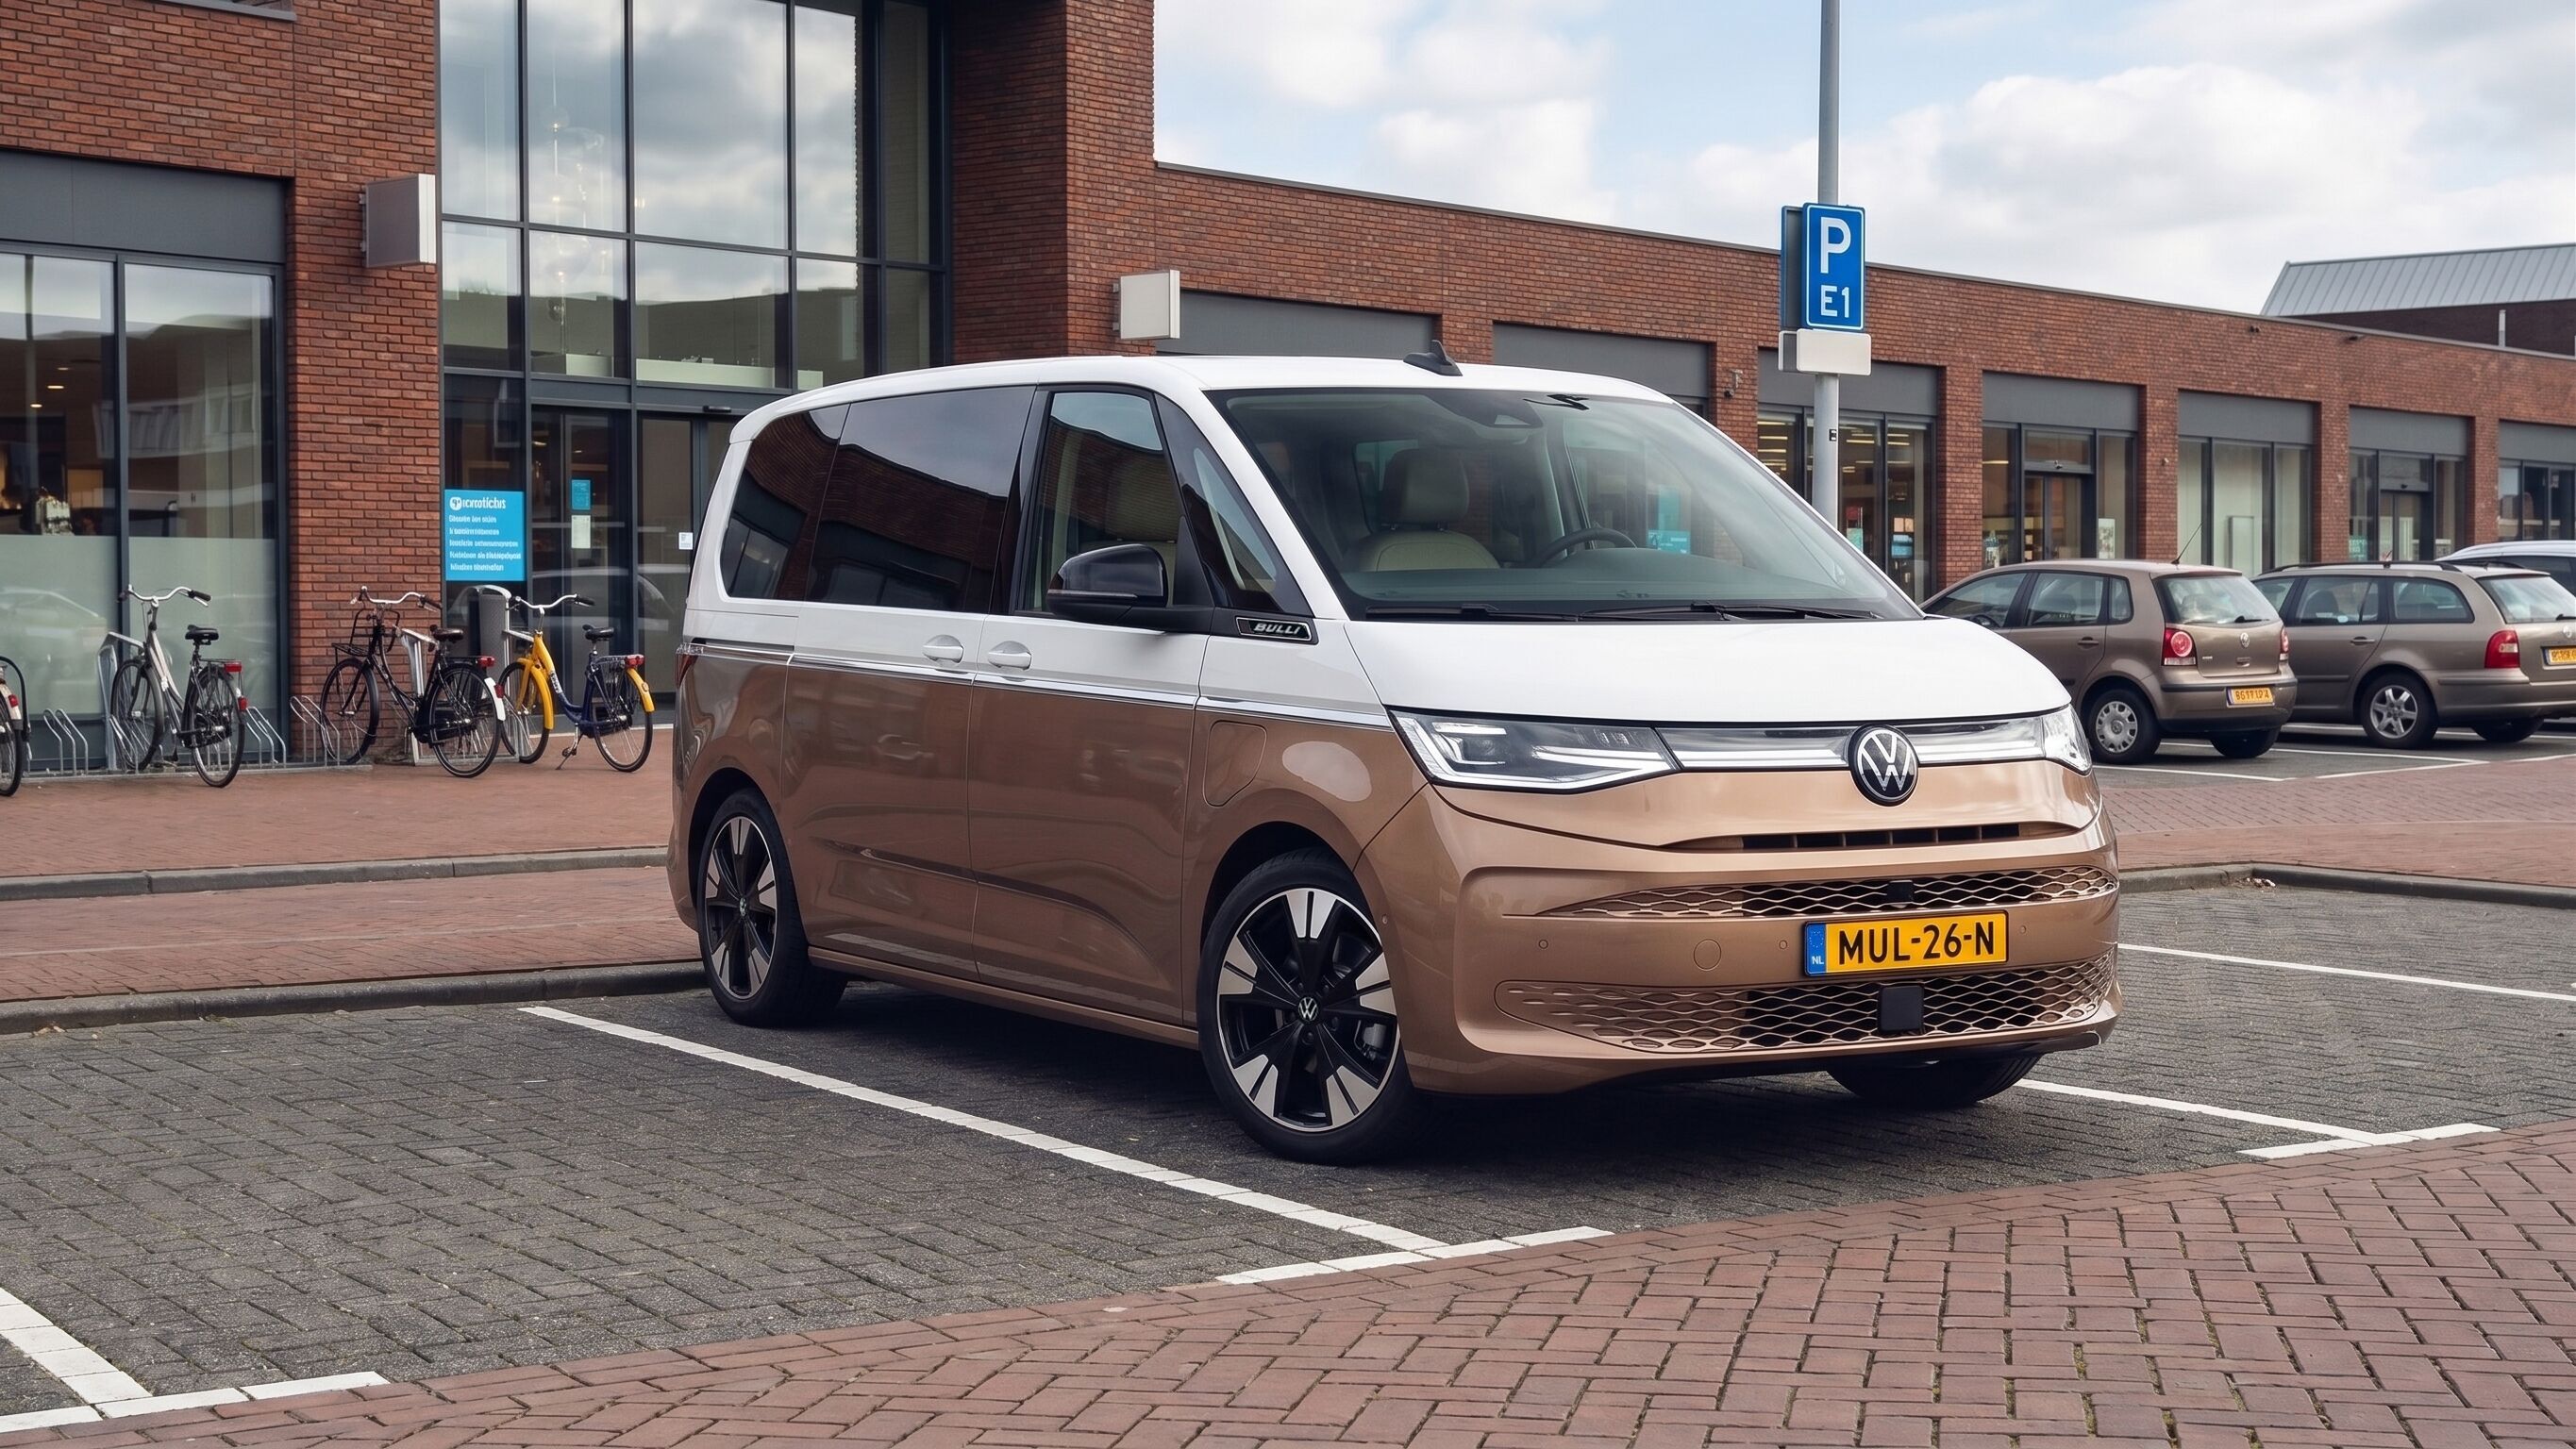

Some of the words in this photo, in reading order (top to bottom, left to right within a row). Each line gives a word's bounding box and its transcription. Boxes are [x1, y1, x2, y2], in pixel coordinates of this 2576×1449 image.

[1820, 216, 1851, 275] P
[1820, 285, 1849, 319] E1
[1253, 623, 1301, 635] BULLI
[1858, 730, 1915, 796] VW
[1811, 956, 1825, 965] NL
[1838, 921, 1995, 966] MUL-26-N
